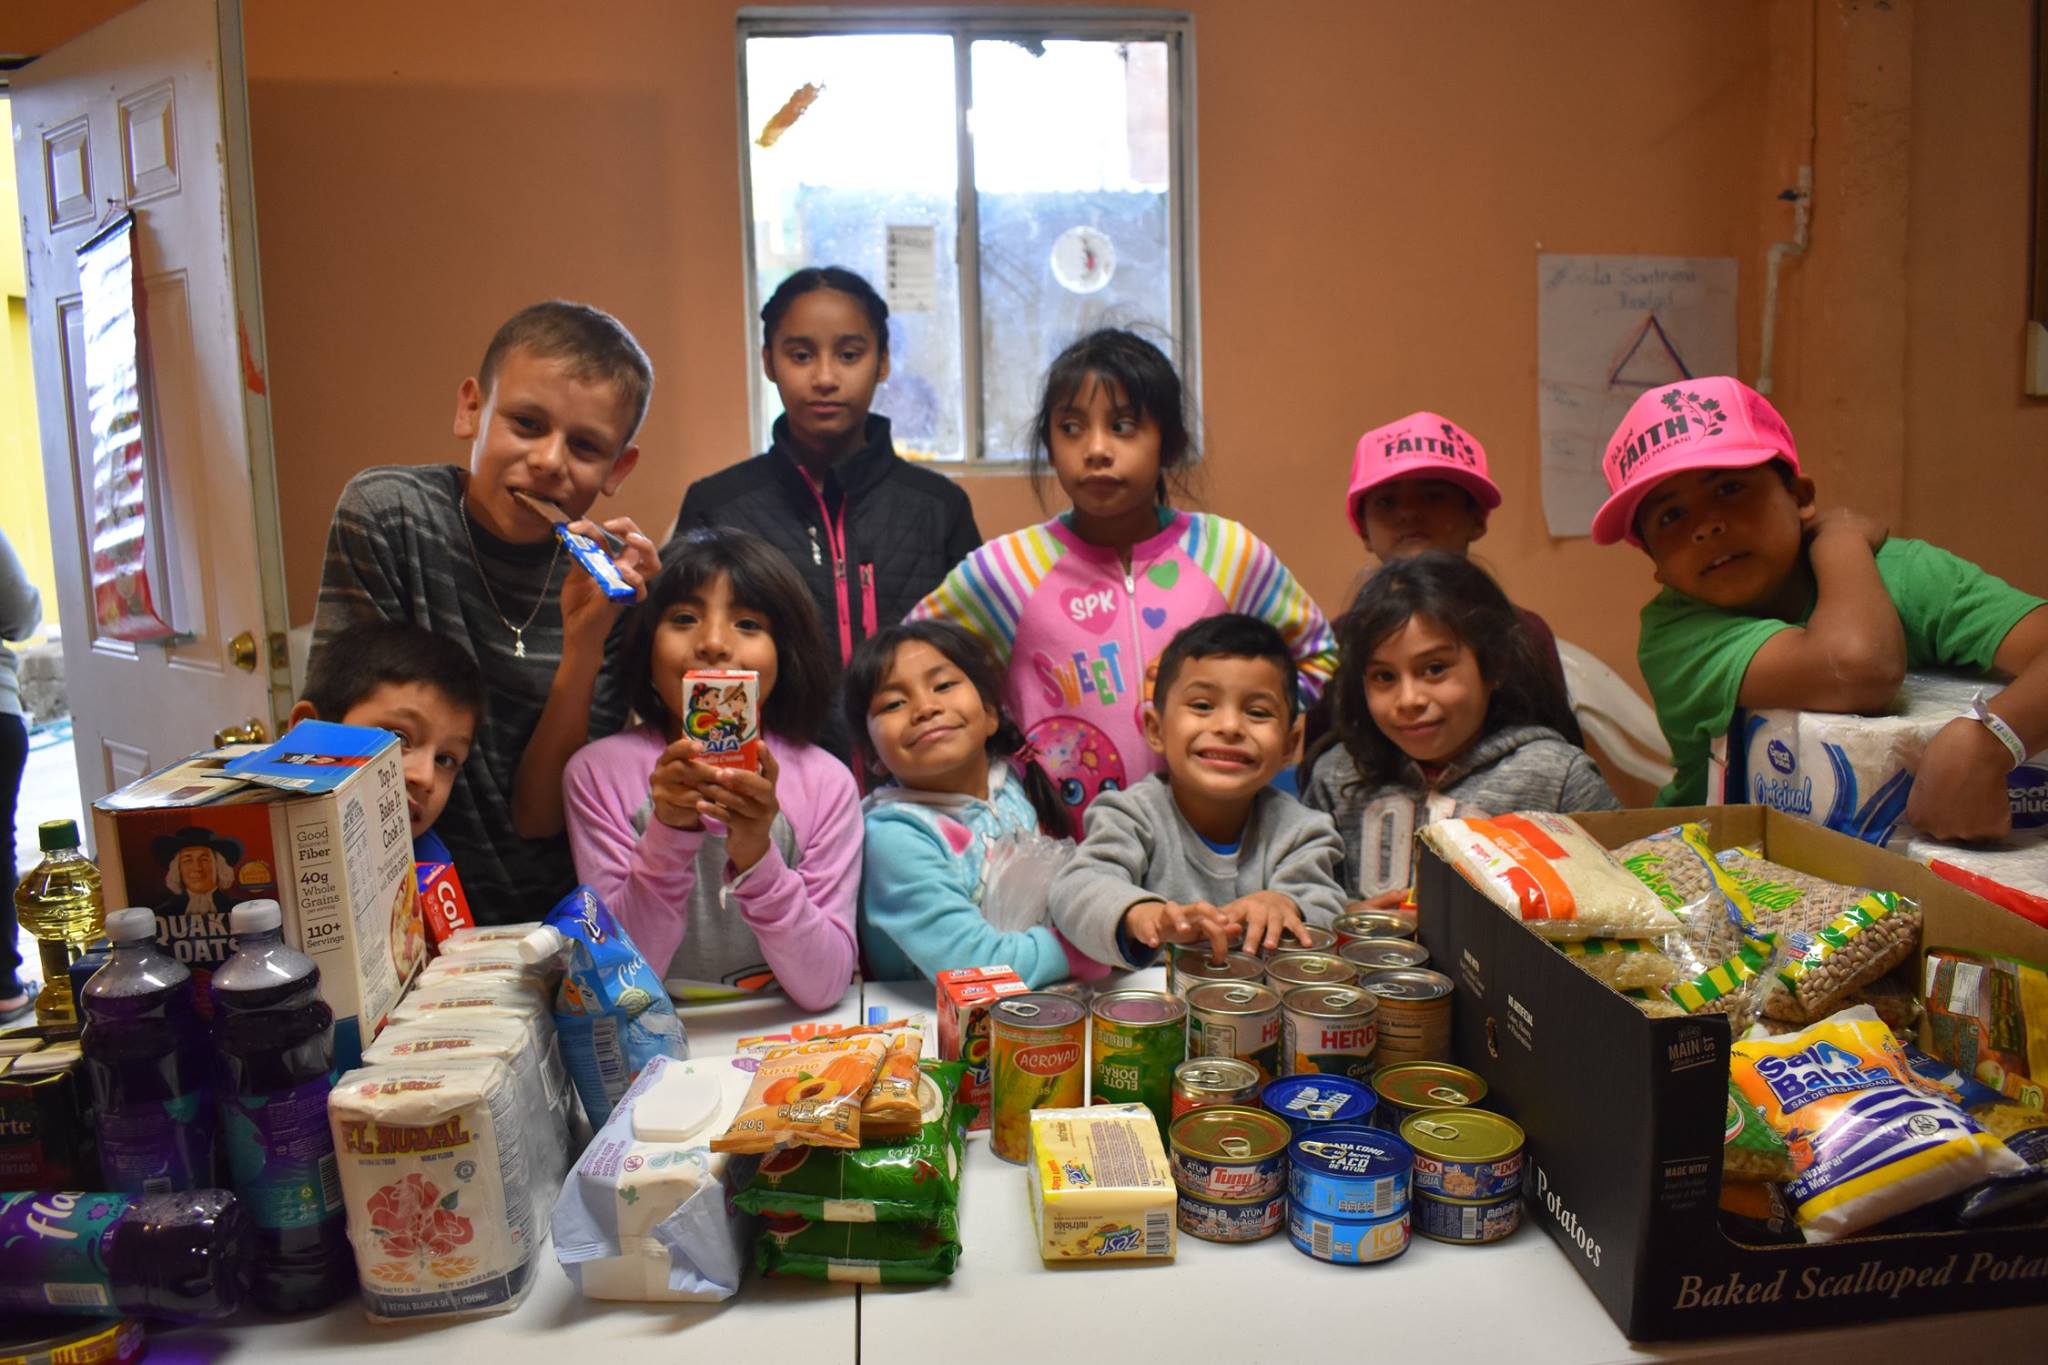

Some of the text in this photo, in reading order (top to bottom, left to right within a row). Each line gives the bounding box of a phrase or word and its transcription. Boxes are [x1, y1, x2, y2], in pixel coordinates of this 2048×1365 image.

[1385, 436, 1455, 458] FAITH
[1619, 414, 1688, 481] FAITH
[1069, 588, 1117, 621] SPK
[1033, 640, 1127, 709] SWEET
[703, 738, 740, 753] ALA
[1753, 772, 1812, 816] Original
[2010, 797, 2048, 813] alue
[296, 826, 329, 842] Good
[298, 847, 331, 861] Fiber
[300, 871, 329, 886] 40g
[302, 883, 336, 898] Whole
[300, 892, 341, 910] Grains
[154, 911, 231, 947] QUAK
[308, 921, 342, 940] 110+
[306, 933, 345, 949] Servings
[1668, 1039, 1700, 1061] MAIN
[1096, 1063, 1139, 1081] DORAD
[1756, 1046, 1823, 1080] Sal
[1103, 1075, 1139, 1091] ELOTE
[1790, 1096, 1811, 1109] SAL
[1812, 1089, 1826, 1102] DE
[1827, 1085, 1851, 1097] MESA
[737, 1119, 765, 1133] 120 g
[1355, 1144, 1385, 1156] COMO
[1663, 1166, 1687, 1177] MADE
[1803, 1155, 1843, 1180] Natural
[1214, 1167, 1254, 1192] Tuny
[1794, 1173, 1832, 1199] de Mar
[1537, 1165, 1602, 1268] Potatoes
[1672, 1250, 2048, 1310] Baked Scalloped Pota
